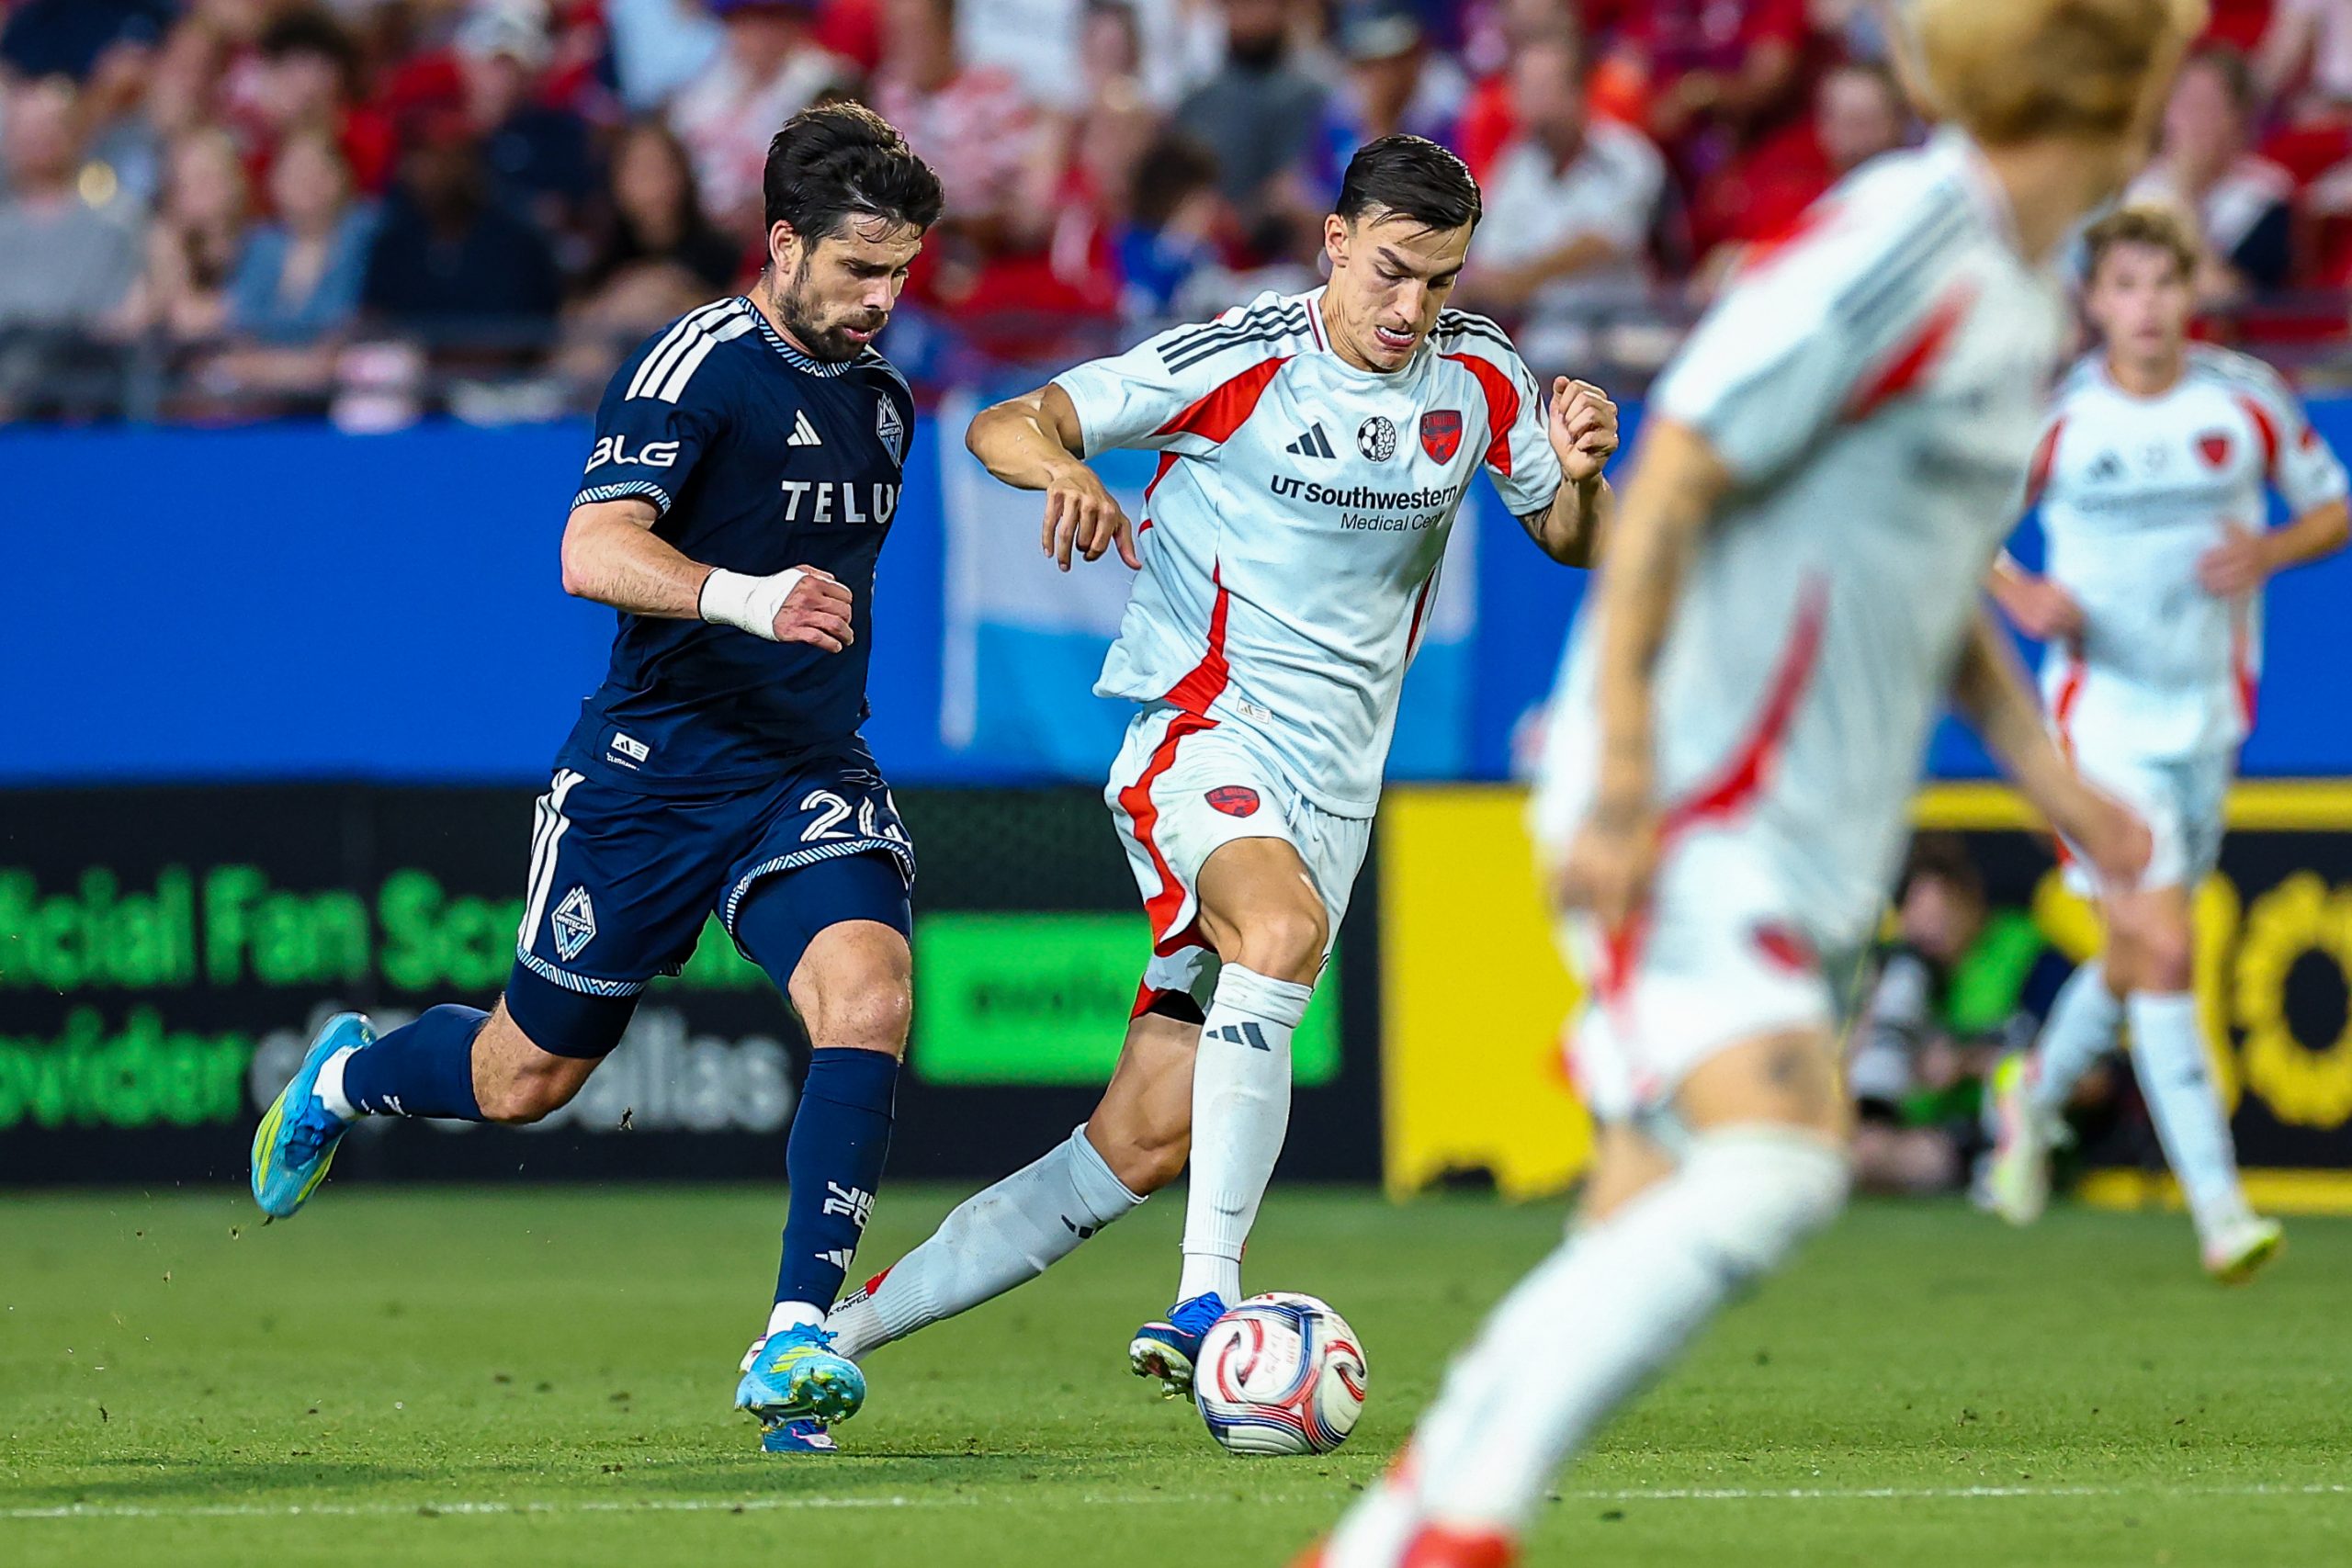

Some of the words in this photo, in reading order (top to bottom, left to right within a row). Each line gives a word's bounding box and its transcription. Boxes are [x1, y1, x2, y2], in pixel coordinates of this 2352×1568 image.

[584, 434, 680, 474] BLG
[781, 479, 903, 525] TELU
[1340, 513, 1409, 531] Medical
[204, 863, 369, 985] Fan
[556, 913, 593, 935] WHITECAPS
